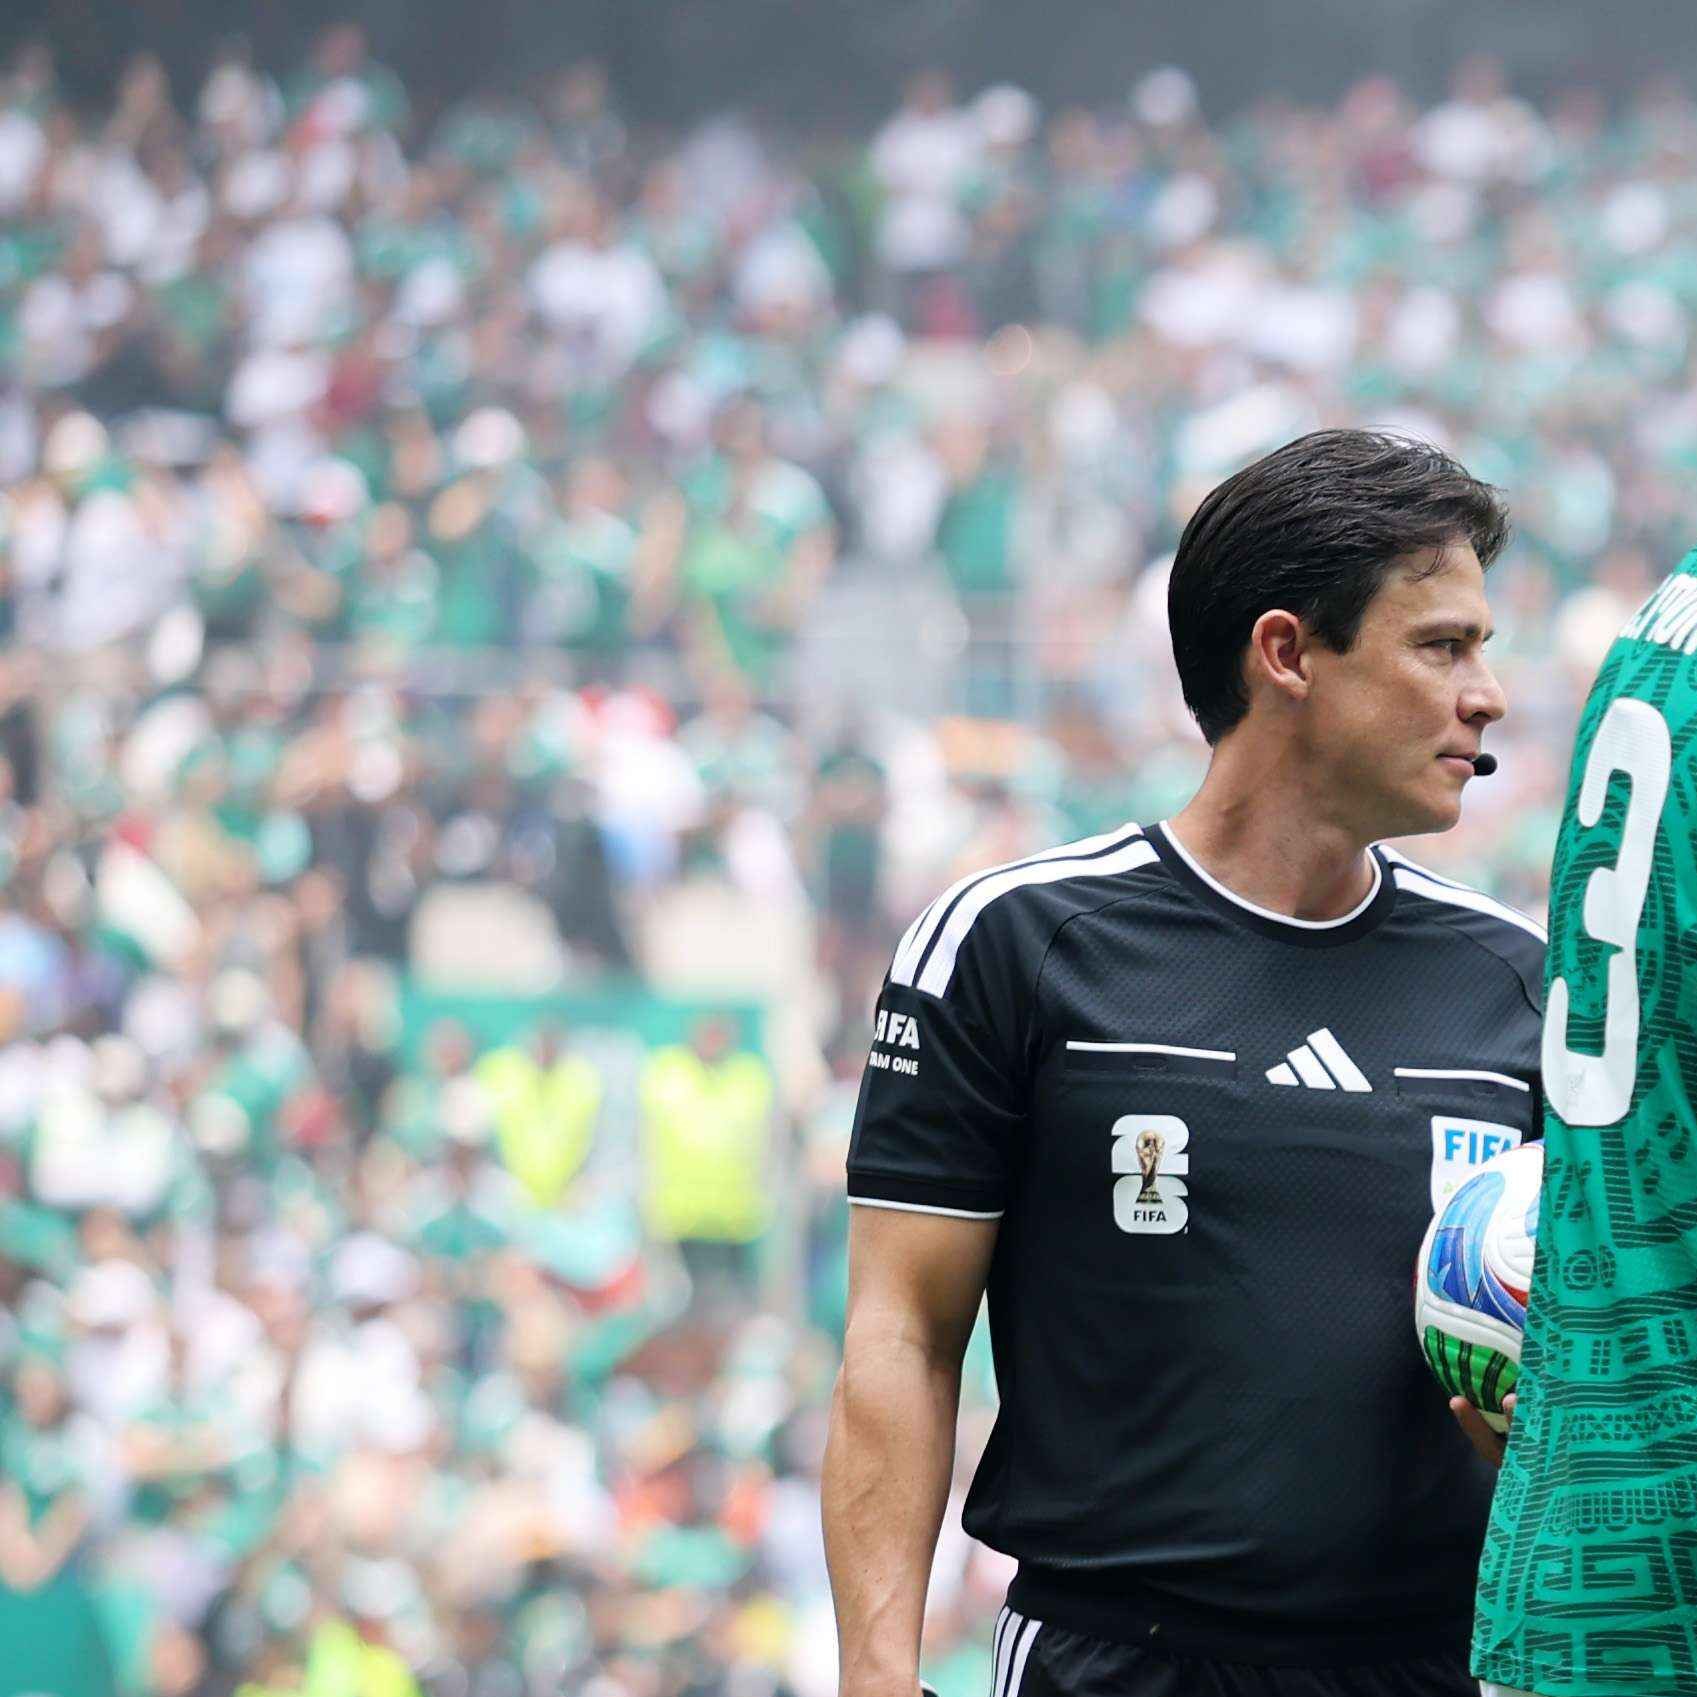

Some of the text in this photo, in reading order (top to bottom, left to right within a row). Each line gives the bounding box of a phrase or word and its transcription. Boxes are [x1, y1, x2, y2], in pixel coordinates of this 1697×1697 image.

[1542, 698, 1672, 1126] 3
[892, 1056, 919, 1076] ONE
[1133, 1210, 1167, 1222] FIFA
